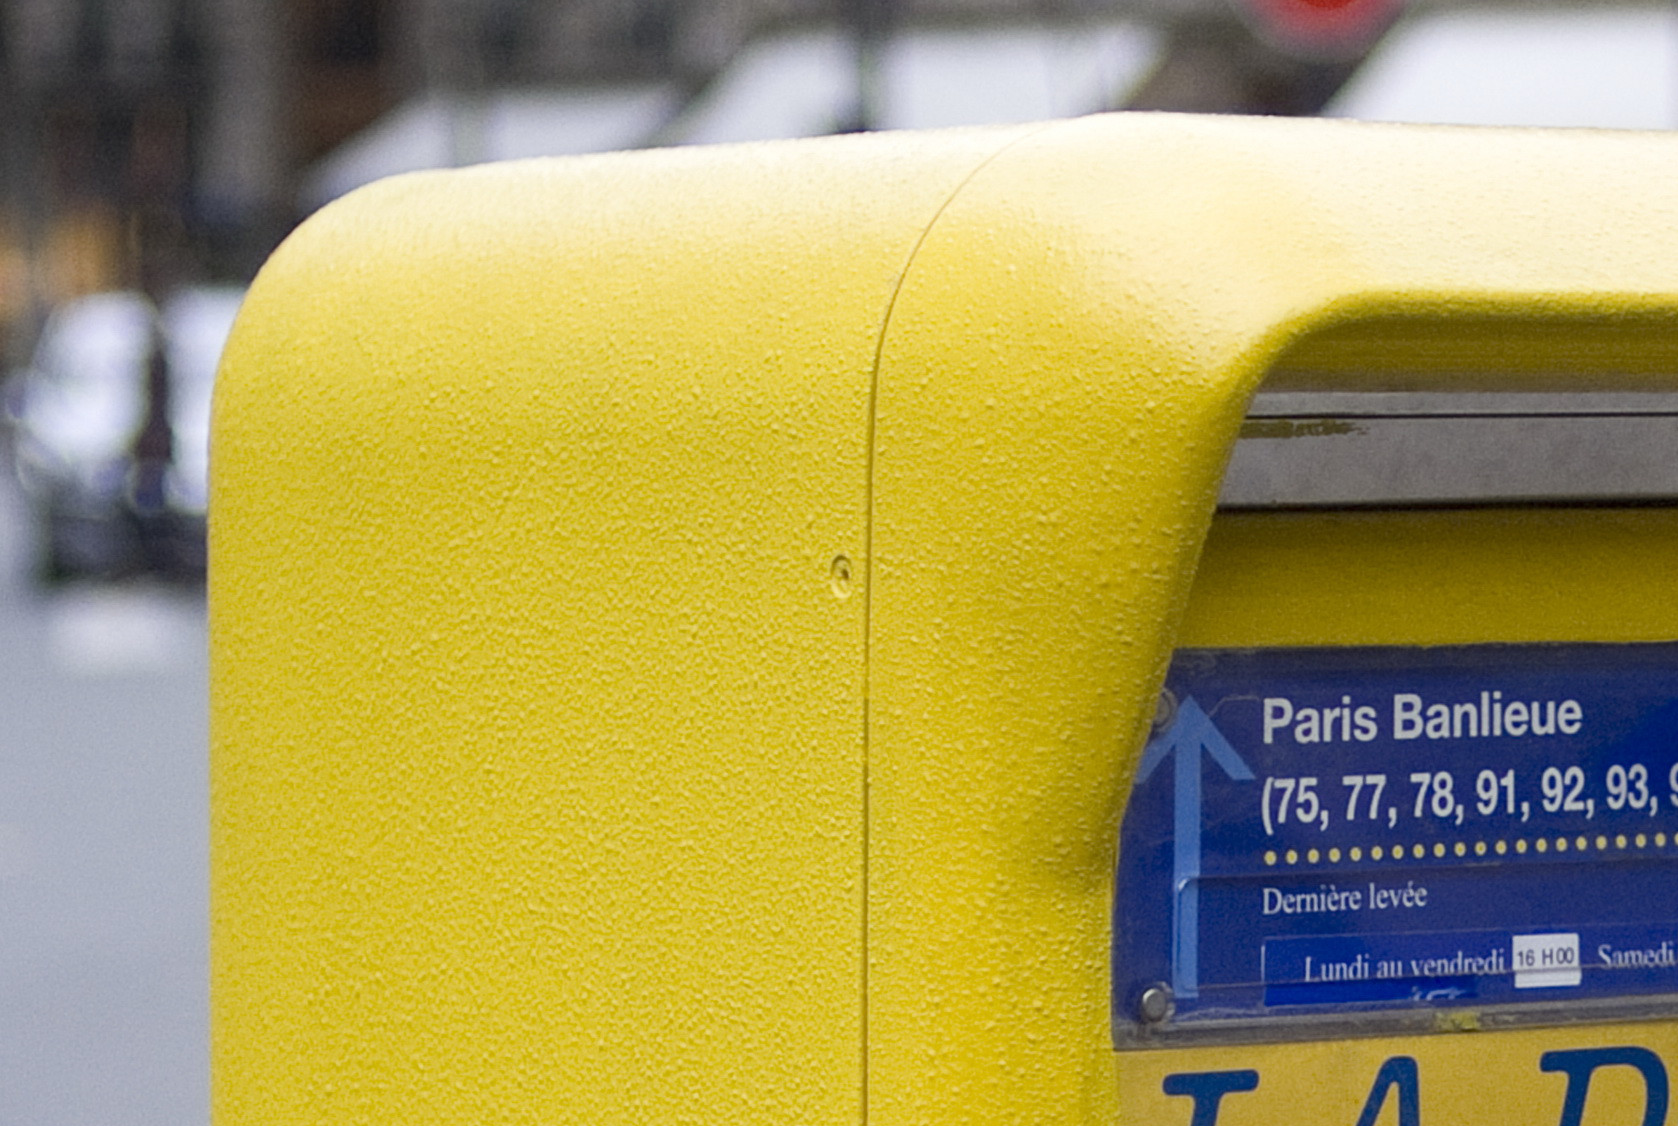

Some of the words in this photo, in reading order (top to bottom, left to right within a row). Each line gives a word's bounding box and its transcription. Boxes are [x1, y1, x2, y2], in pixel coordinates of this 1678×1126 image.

[1262, 695, 1378, 745] Paris
[1393, 692, 1583, 742] Banlieue
[1261, 776, 1328, 837] (75,
[1343, 773, 1397, 830] 77,
[1410, 770, 1464, 826] 78,
[1476, 768, 1529, 821] 91,
[1542, 766, 1594, 817] 92,
[1606, 764, 1659, 815] 93,
[1262, 885, 1361, 916] Dernière
[1369, 880, 1427, 912] levée
[1304, 955, 1369, 982] Lundi
[1376, 961, 1403, 979] au
[1411, 948, 1505, 976] vendredi
[1517, 950, 1535, 967] 16
[1598, 942, 1674, 967] Samedi
